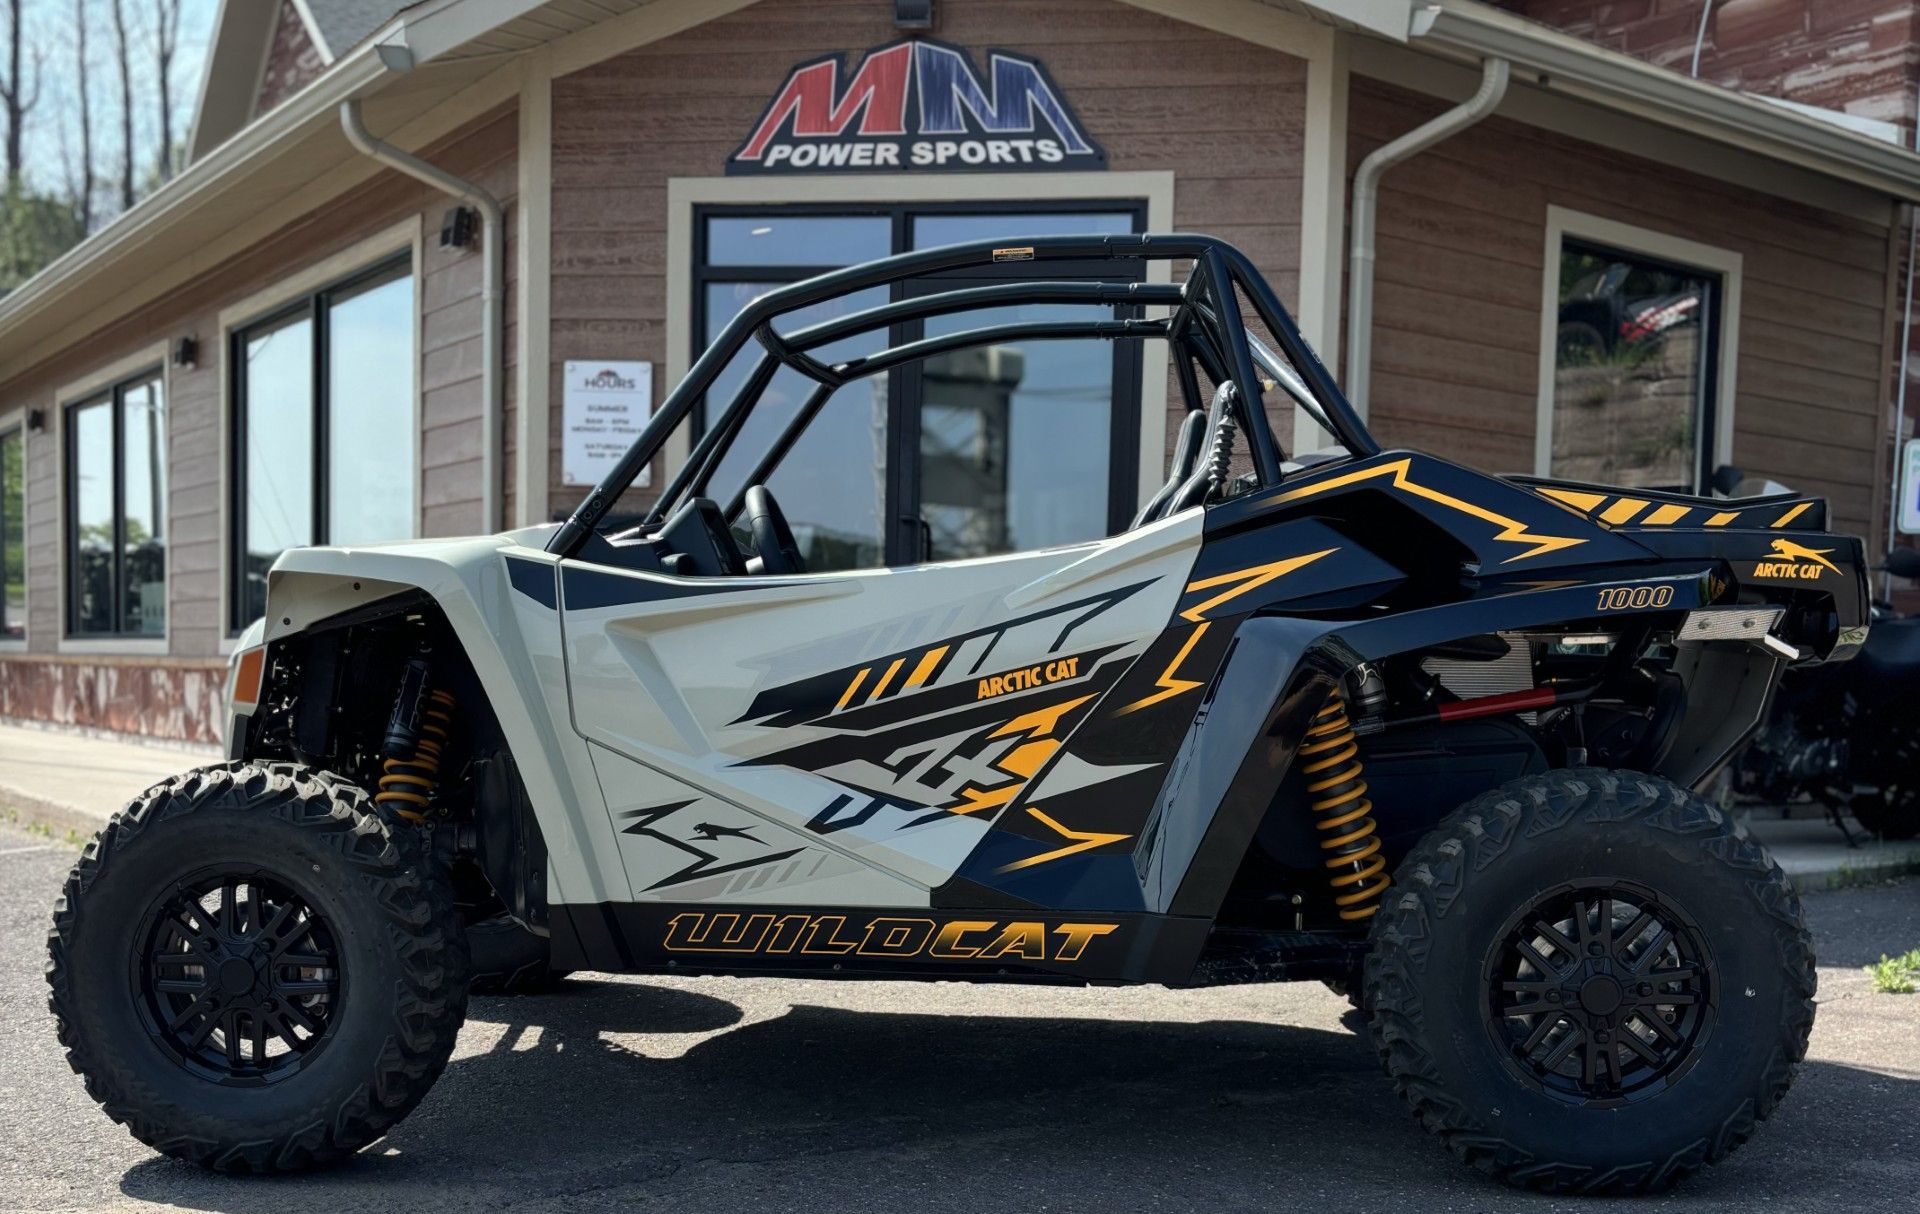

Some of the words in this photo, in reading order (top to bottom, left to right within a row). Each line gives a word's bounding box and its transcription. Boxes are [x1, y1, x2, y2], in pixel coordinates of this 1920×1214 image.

[763, 142, 900, 168] POWER
[911, 140, 1063, 165] SPORTS
[585, 378, 635, 389] HOURS
[1753, 562, 1799, 578] ARCTIC
[1800, 564, 1824, 579] CAT
[1598, 585, 1675, 610] 1000
[977, 666, 1042, 700] ARCTIC
[1045, 657, 1079, 682] CAT
[663, 913, 1121, 961] WILDCAT
